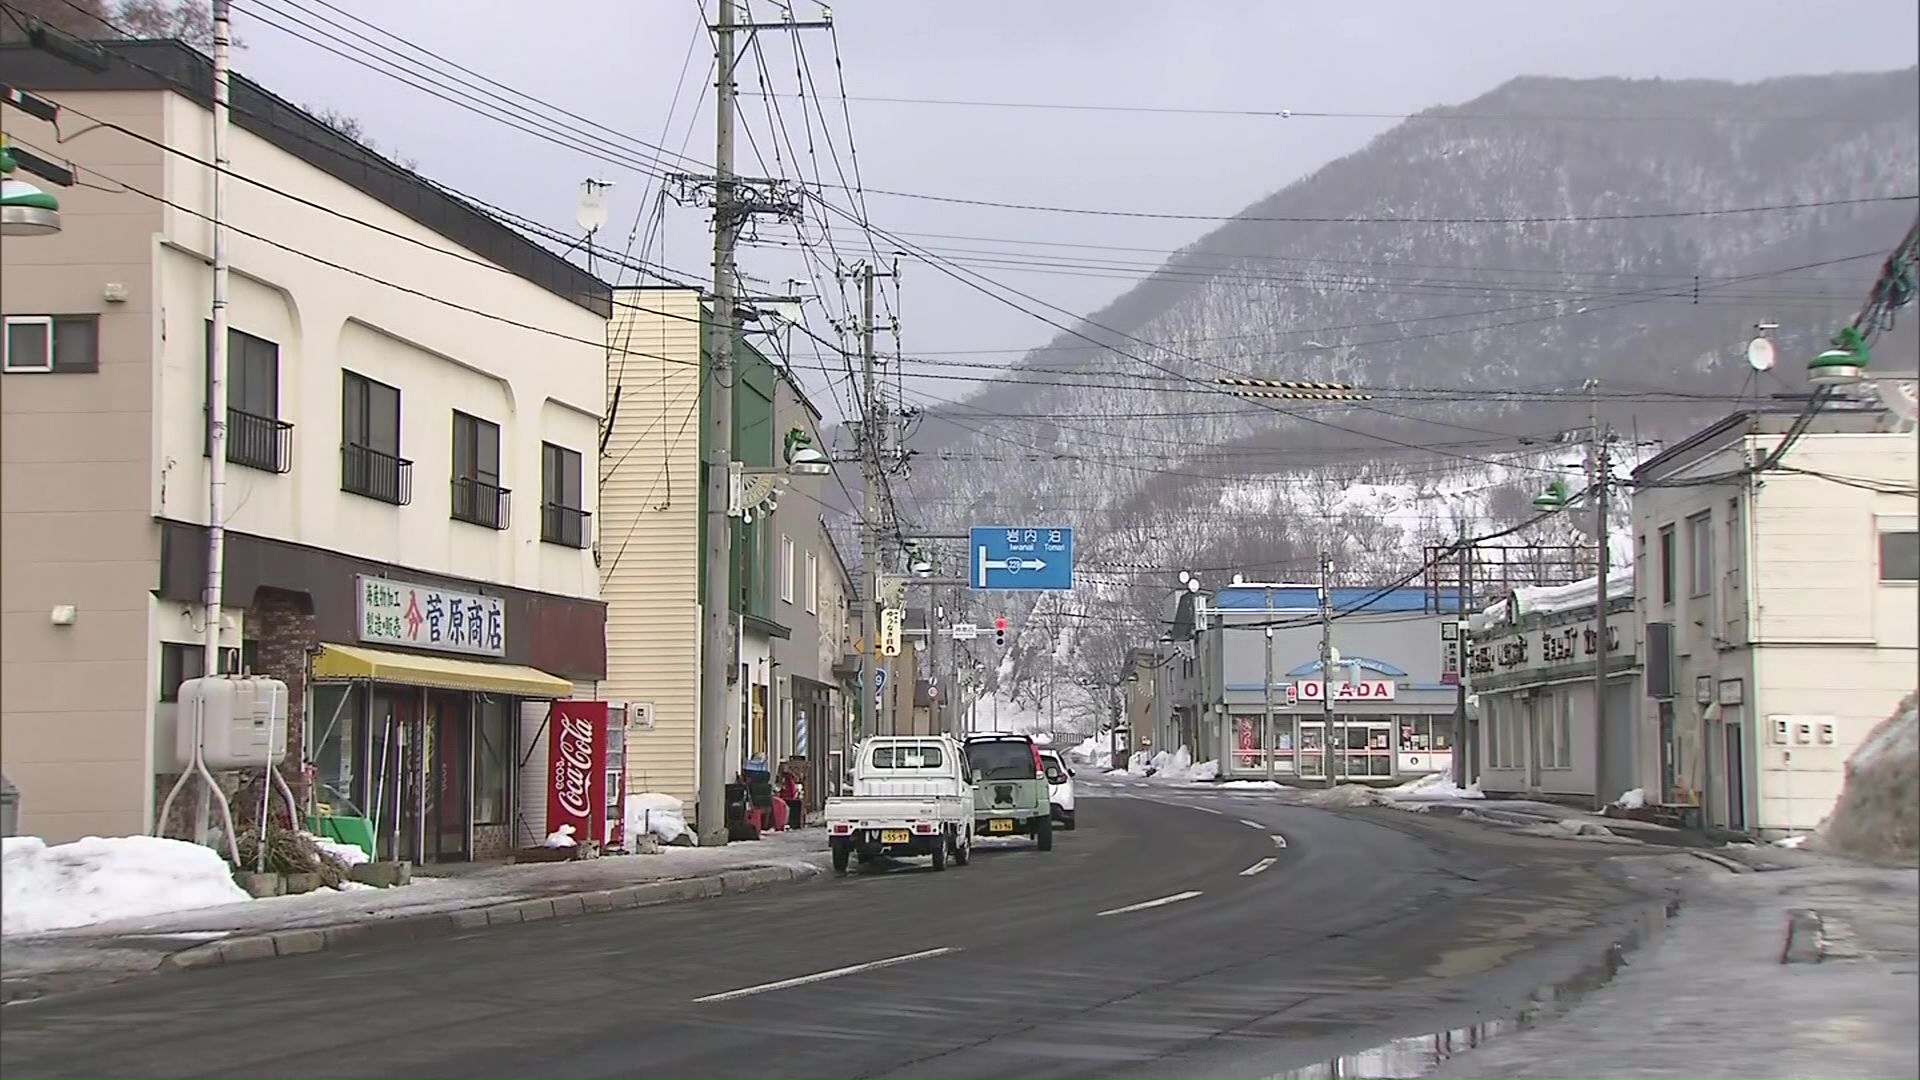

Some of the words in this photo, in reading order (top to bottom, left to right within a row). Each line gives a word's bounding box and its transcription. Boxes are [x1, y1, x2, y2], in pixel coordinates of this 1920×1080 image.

[1006, 528, 1038, 543] 岩内
[1047, 528, 1061, 543] 泊
[1009, 543, 1035, 551] Iwanai
[1043, 543, 1065, 551] Tomari
[426, 592, 502, 650] 菅原商店
[1304, 682, 1388, 698] OADA
[559, 711, 593, 817] Coca-Cola
